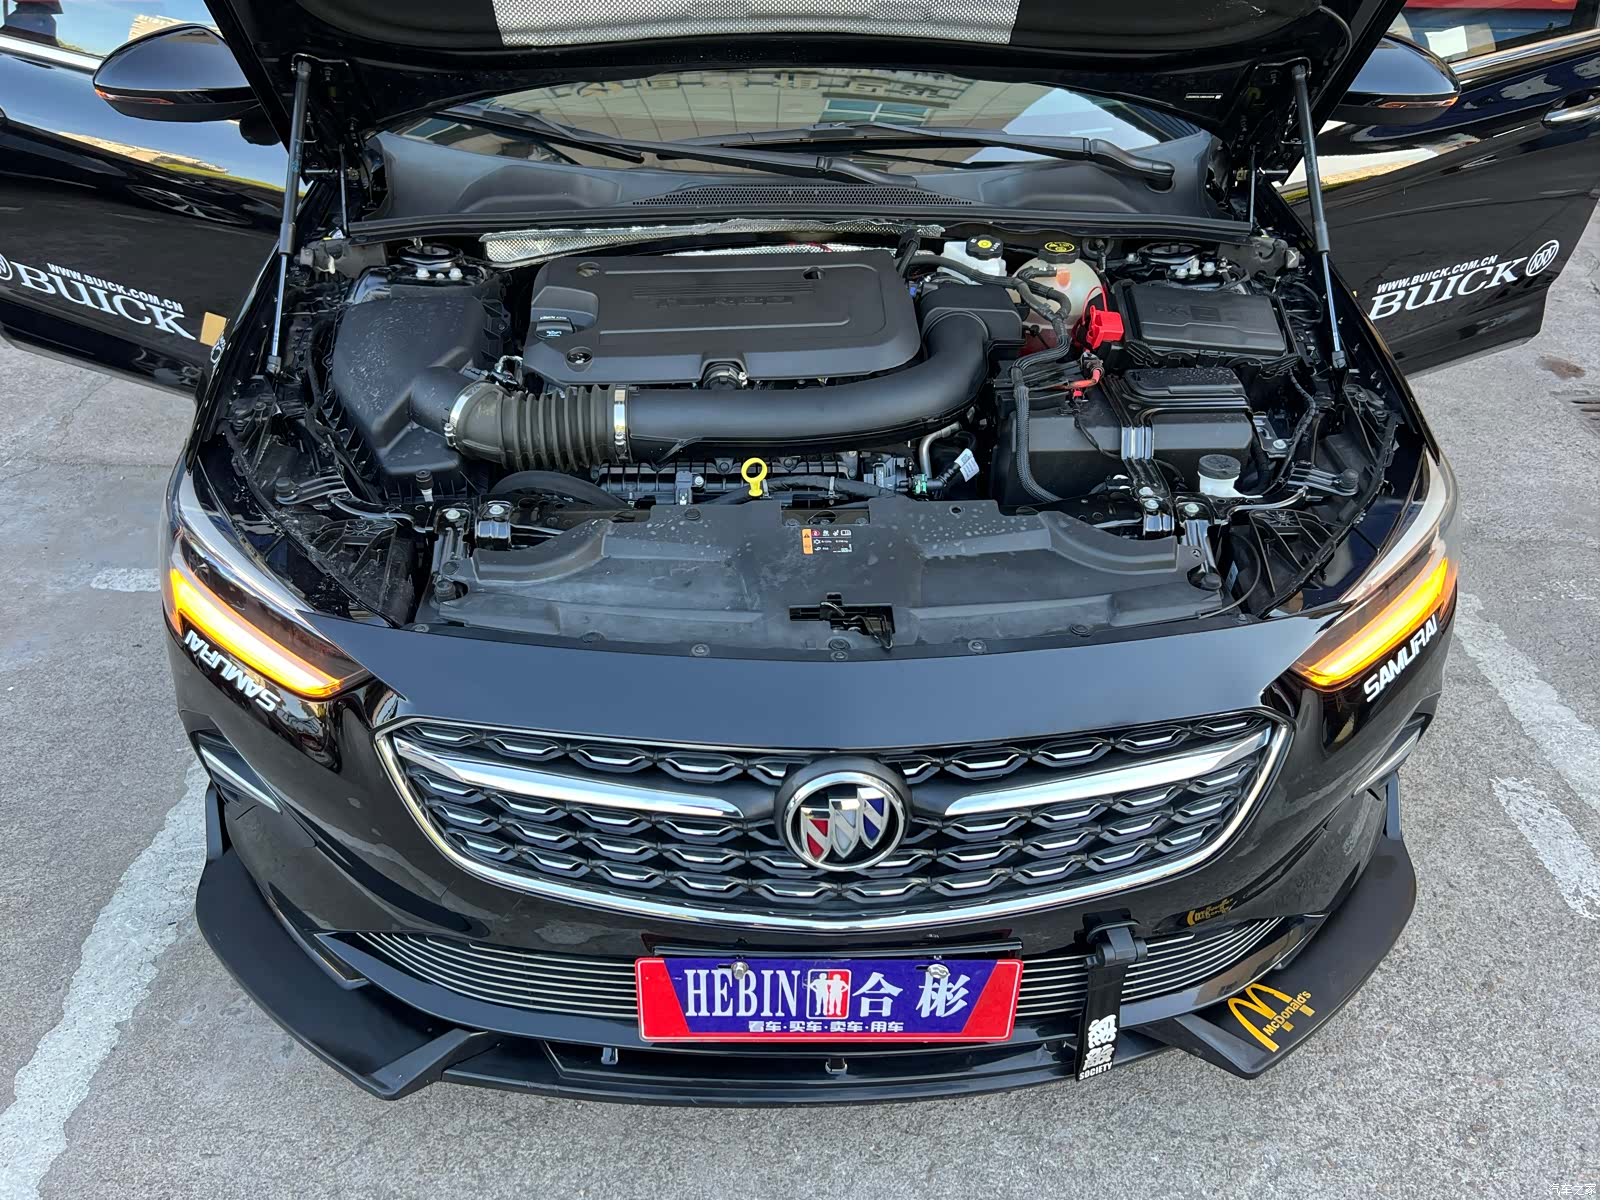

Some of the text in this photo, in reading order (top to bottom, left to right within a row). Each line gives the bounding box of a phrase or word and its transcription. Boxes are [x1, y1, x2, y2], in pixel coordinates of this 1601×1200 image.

[47, 262, 184, 313] WWW.BUICK.COM.CN
[1370, 256, 1528, 321] BUICK
[1376, 254, 1498, 294] WWW.BUICK.COM.CN
[10, 261, 196, 340] BUICK
[184, 629, 281, 712] SAMURAI
[1363, 613, 1437, 702] SAMURAI
[684, 969, 801, 1017] HEBIN
[1262, 991, 1312, 1037] McDonald's
[1079, 1061, 1113, 1081] SOCIETY
